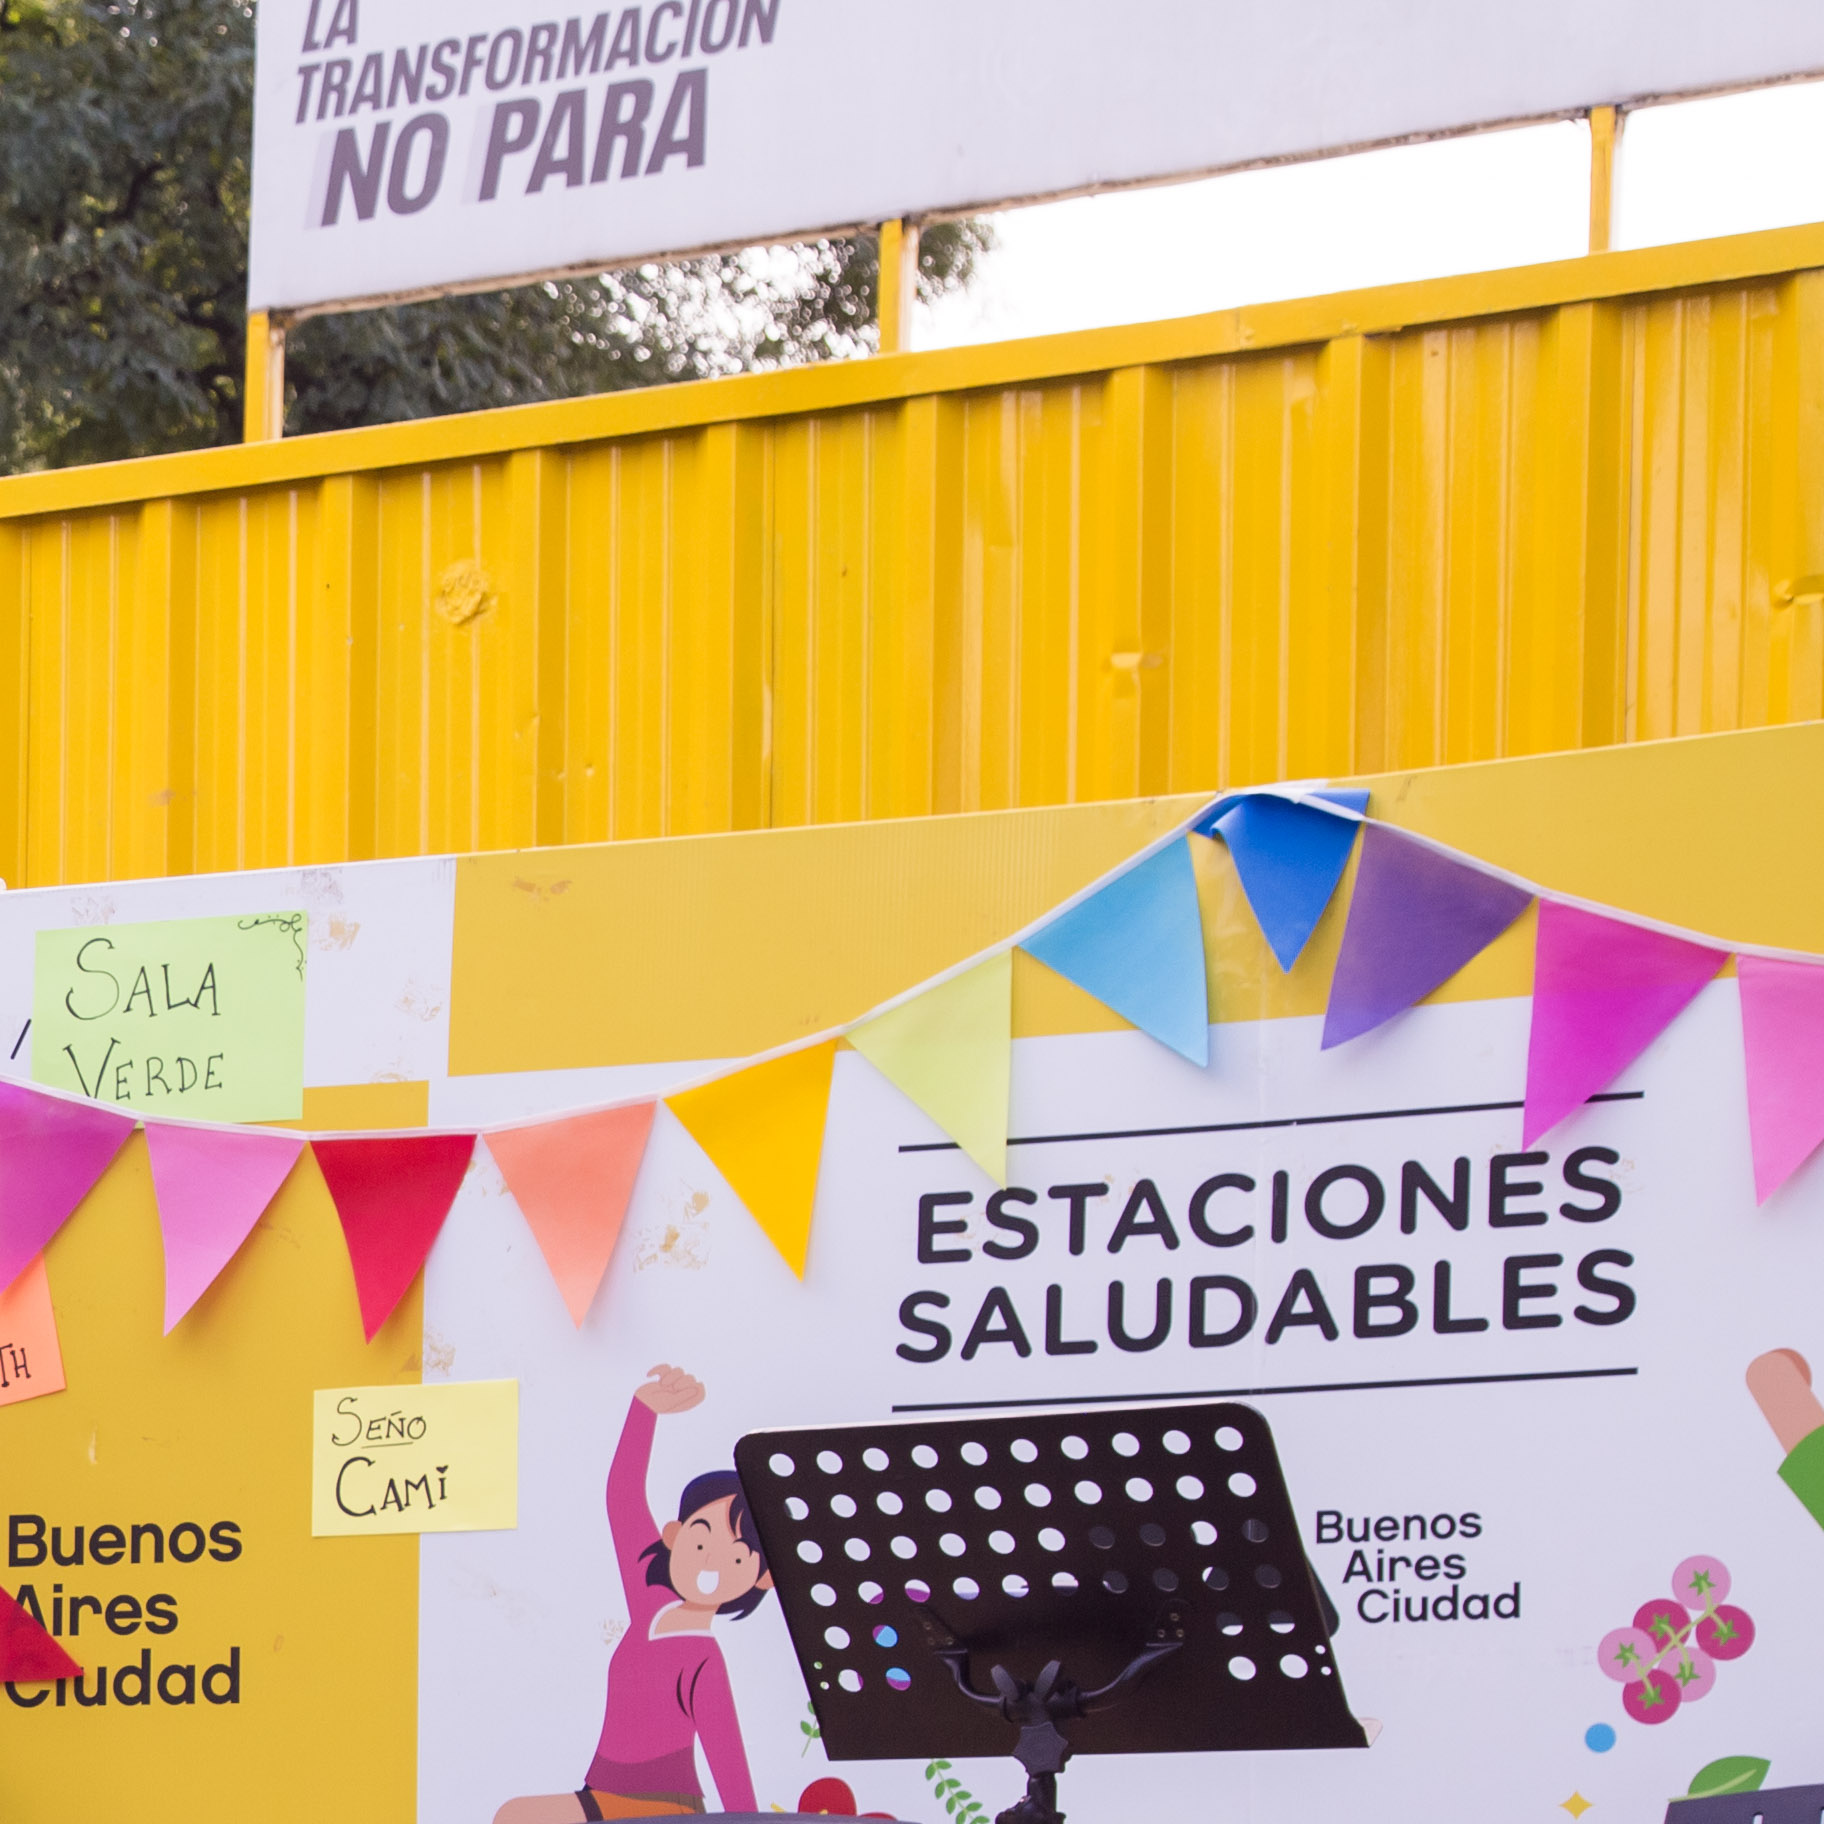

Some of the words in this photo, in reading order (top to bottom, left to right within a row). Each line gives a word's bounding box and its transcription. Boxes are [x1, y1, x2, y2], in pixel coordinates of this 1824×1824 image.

[301, 0, 358, 53] LA
[318, 112, 450, 228] NO
[477, 67, 709, 202] PARA
[65, 937, 221, 1021] SALA
[62, 1037, 224, 1101] VERDE
[917, 1146, 1623, 1264] ESTACIONES
[895, 1248, 1637, 1364] SALUDABLES
[331, 1396, 427, 1447] SEÑO
[8, 1513, 243, 1568] Buenos
[1316, 1509, 1483, 1544] Buenos
[1342, 1548, 1467, 1584] Aires
[1357, 1581, 1521, 1624] Ciudad
